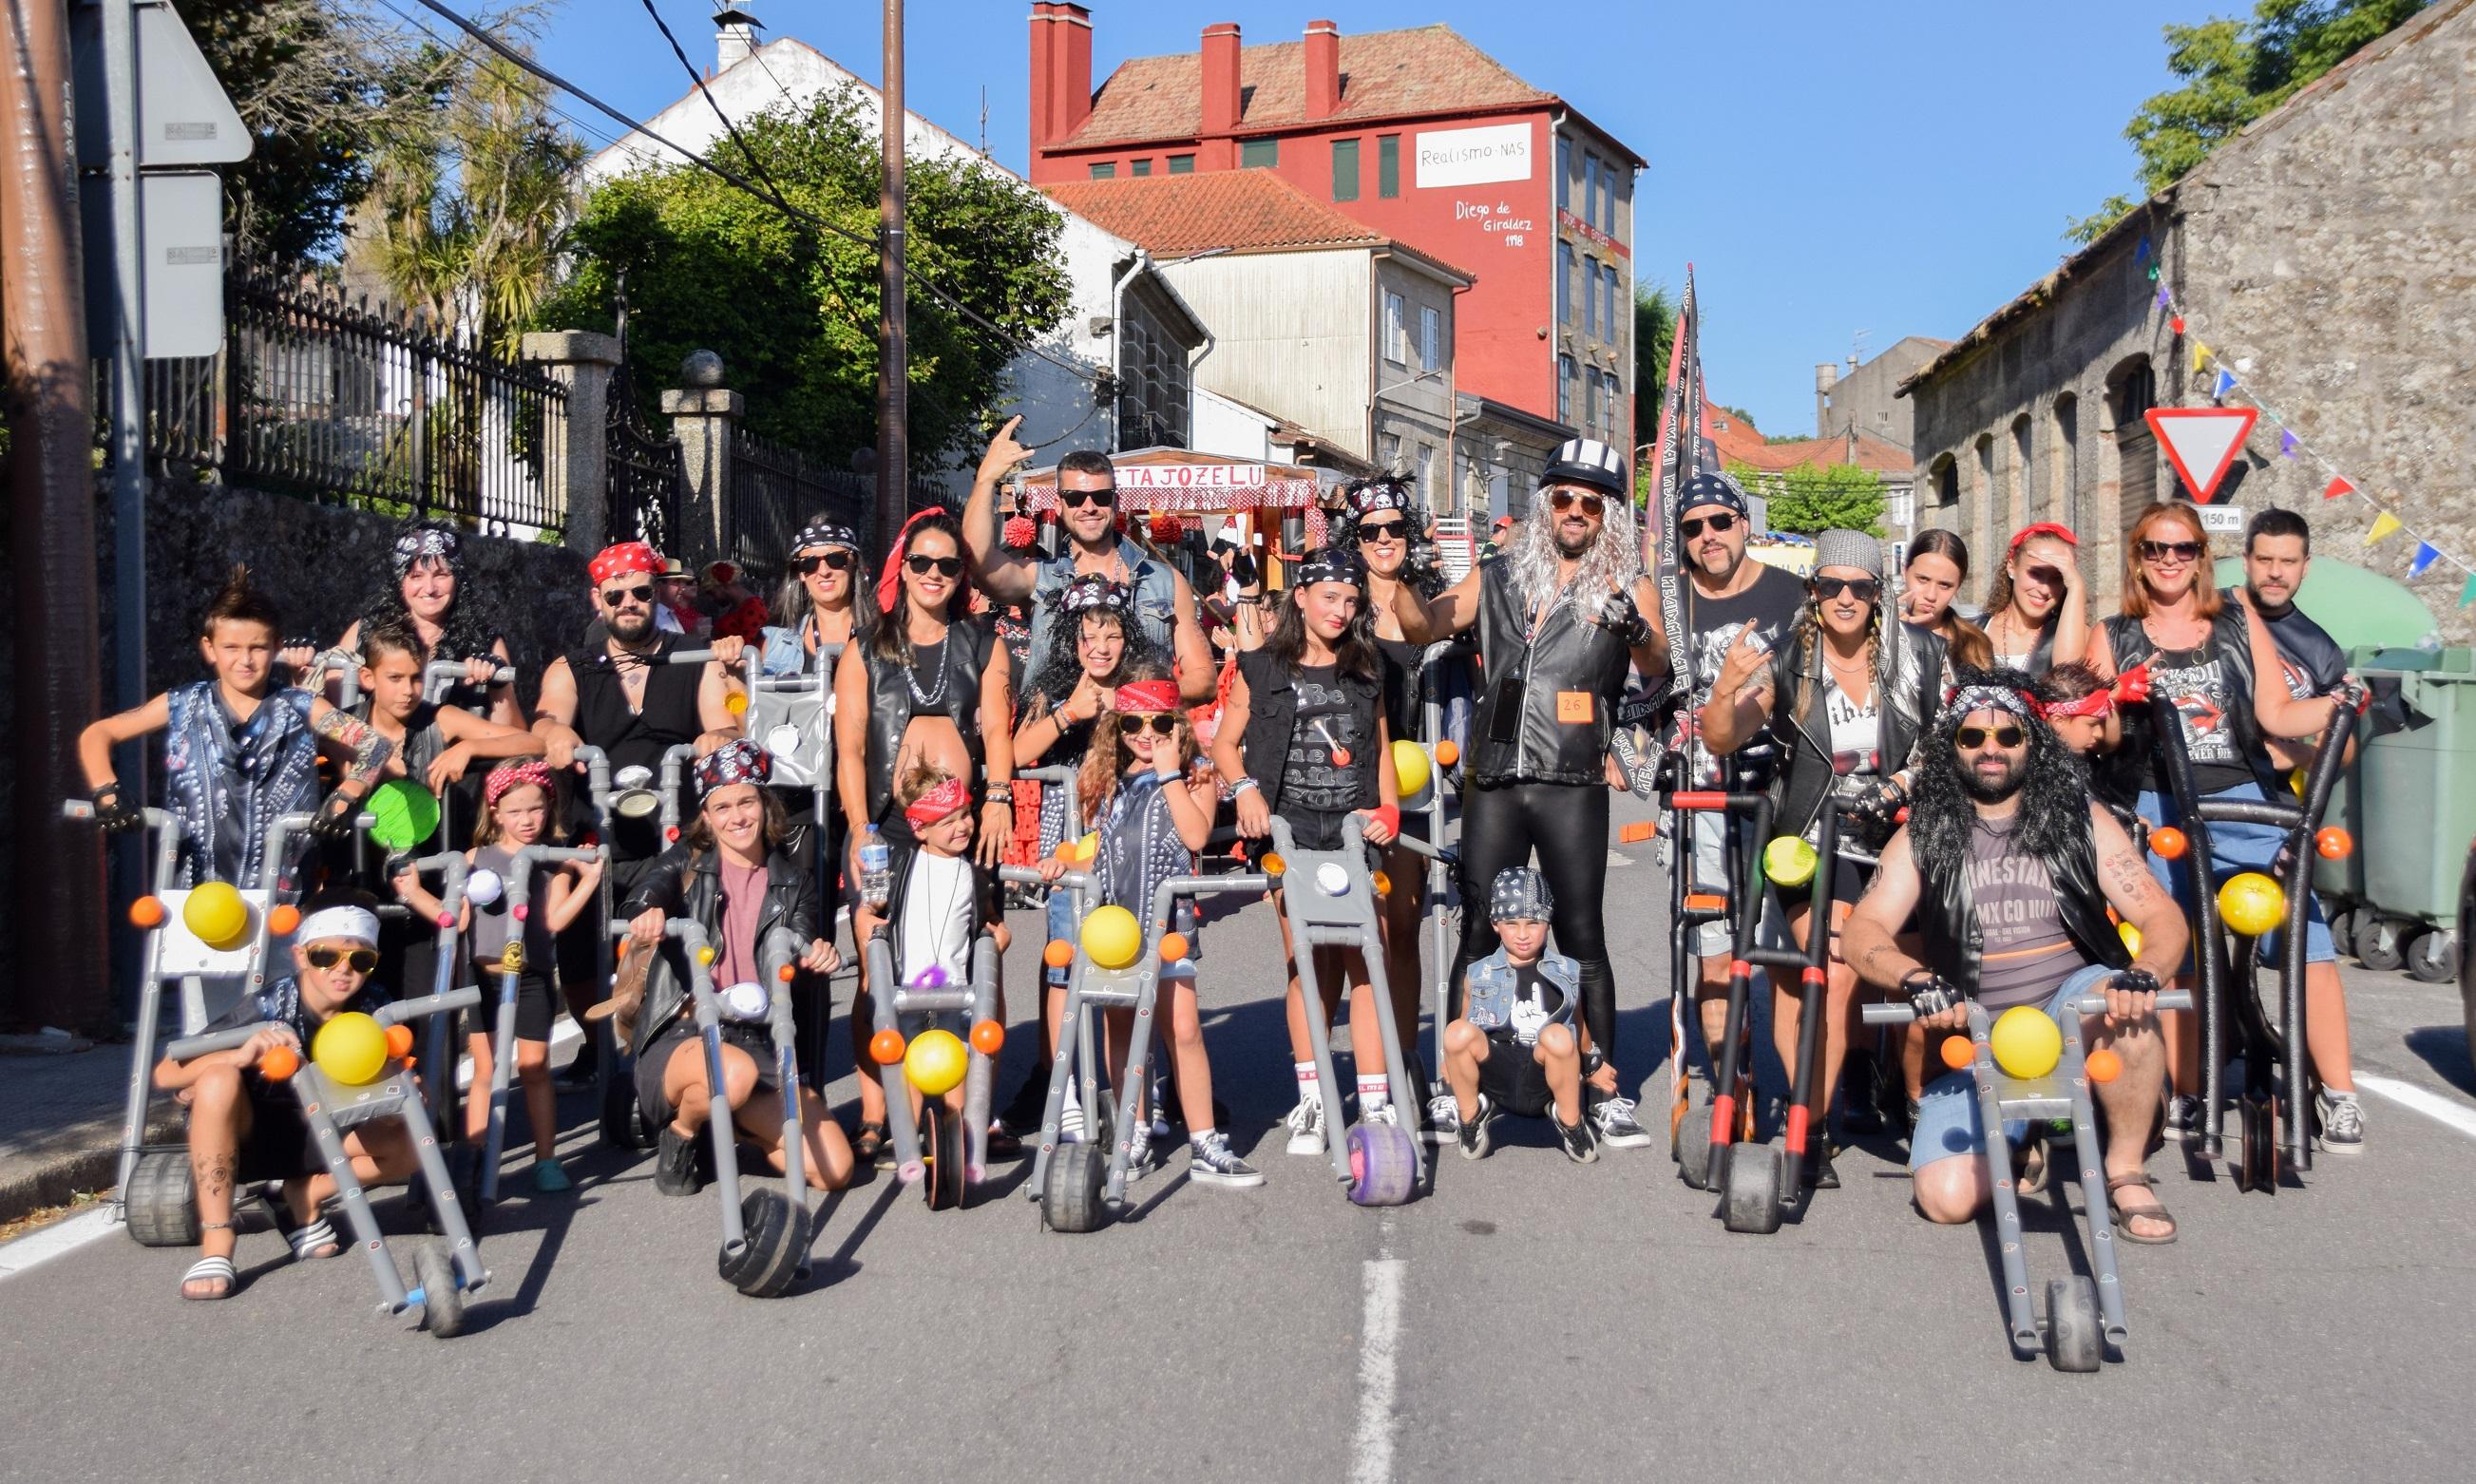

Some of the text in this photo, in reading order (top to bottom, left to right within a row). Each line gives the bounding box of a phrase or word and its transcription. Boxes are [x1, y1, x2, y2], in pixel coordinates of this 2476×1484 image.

[1456, 200, 1511, 221] Diego de
[1114, 467, 1154, 486] TA
[2202, 513, 2238, 525] 150 m
[1564, 699, 1581, 711] 26
